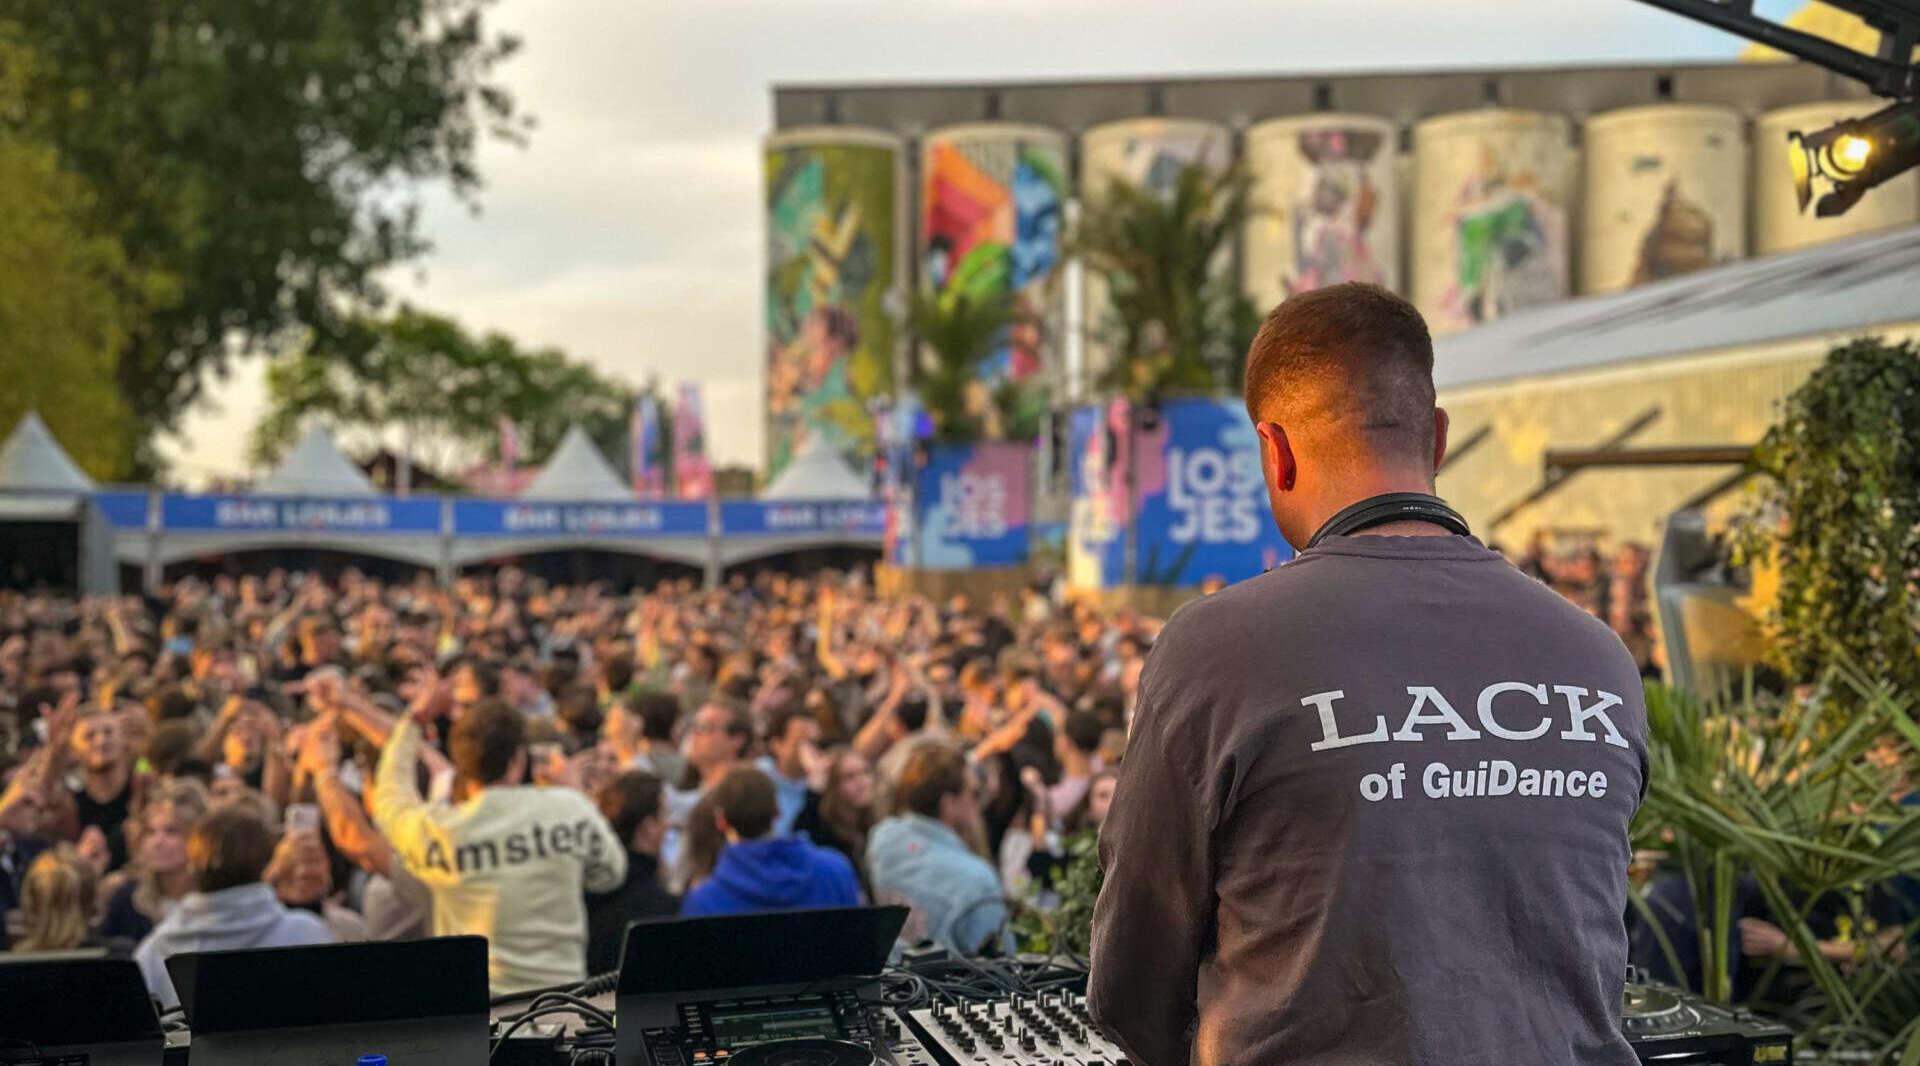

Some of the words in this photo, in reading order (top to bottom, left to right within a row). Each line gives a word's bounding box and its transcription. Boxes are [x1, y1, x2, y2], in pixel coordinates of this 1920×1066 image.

[1169, 448, 1260, 509] LOS
[1169, 499, 1260, 544] JES
[1301, 682, 1629, 751] LACK
[1360, 763, 1406, 802] of
[1423, 760, 1608, 799] GuiDance
